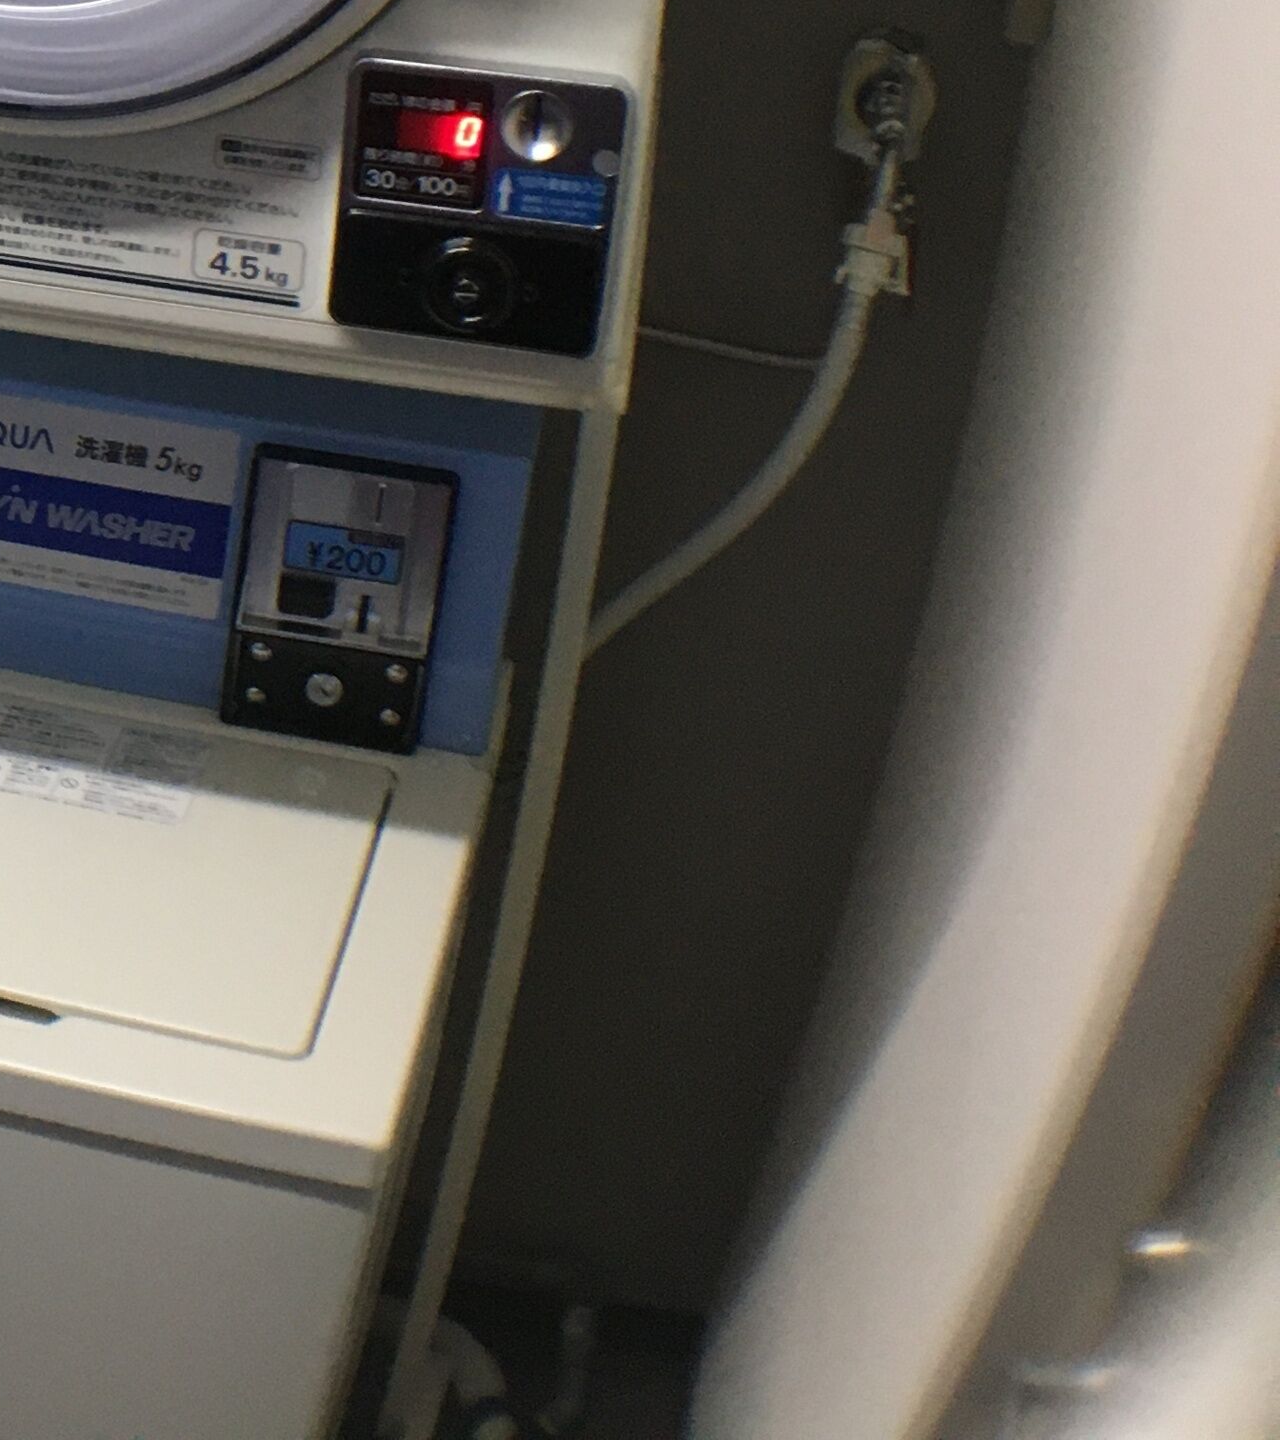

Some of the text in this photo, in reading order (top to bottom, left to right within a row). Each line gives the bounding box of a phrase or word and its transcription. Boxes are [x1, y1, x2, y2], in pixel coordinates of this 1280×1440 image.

[454, 116, 483, 148] 0
[208, 250, 289, 288] 4.5 kg
[74, 434, 204, 482] 洗濯機 5kg
[46, 502, 196, 552] WASHER
